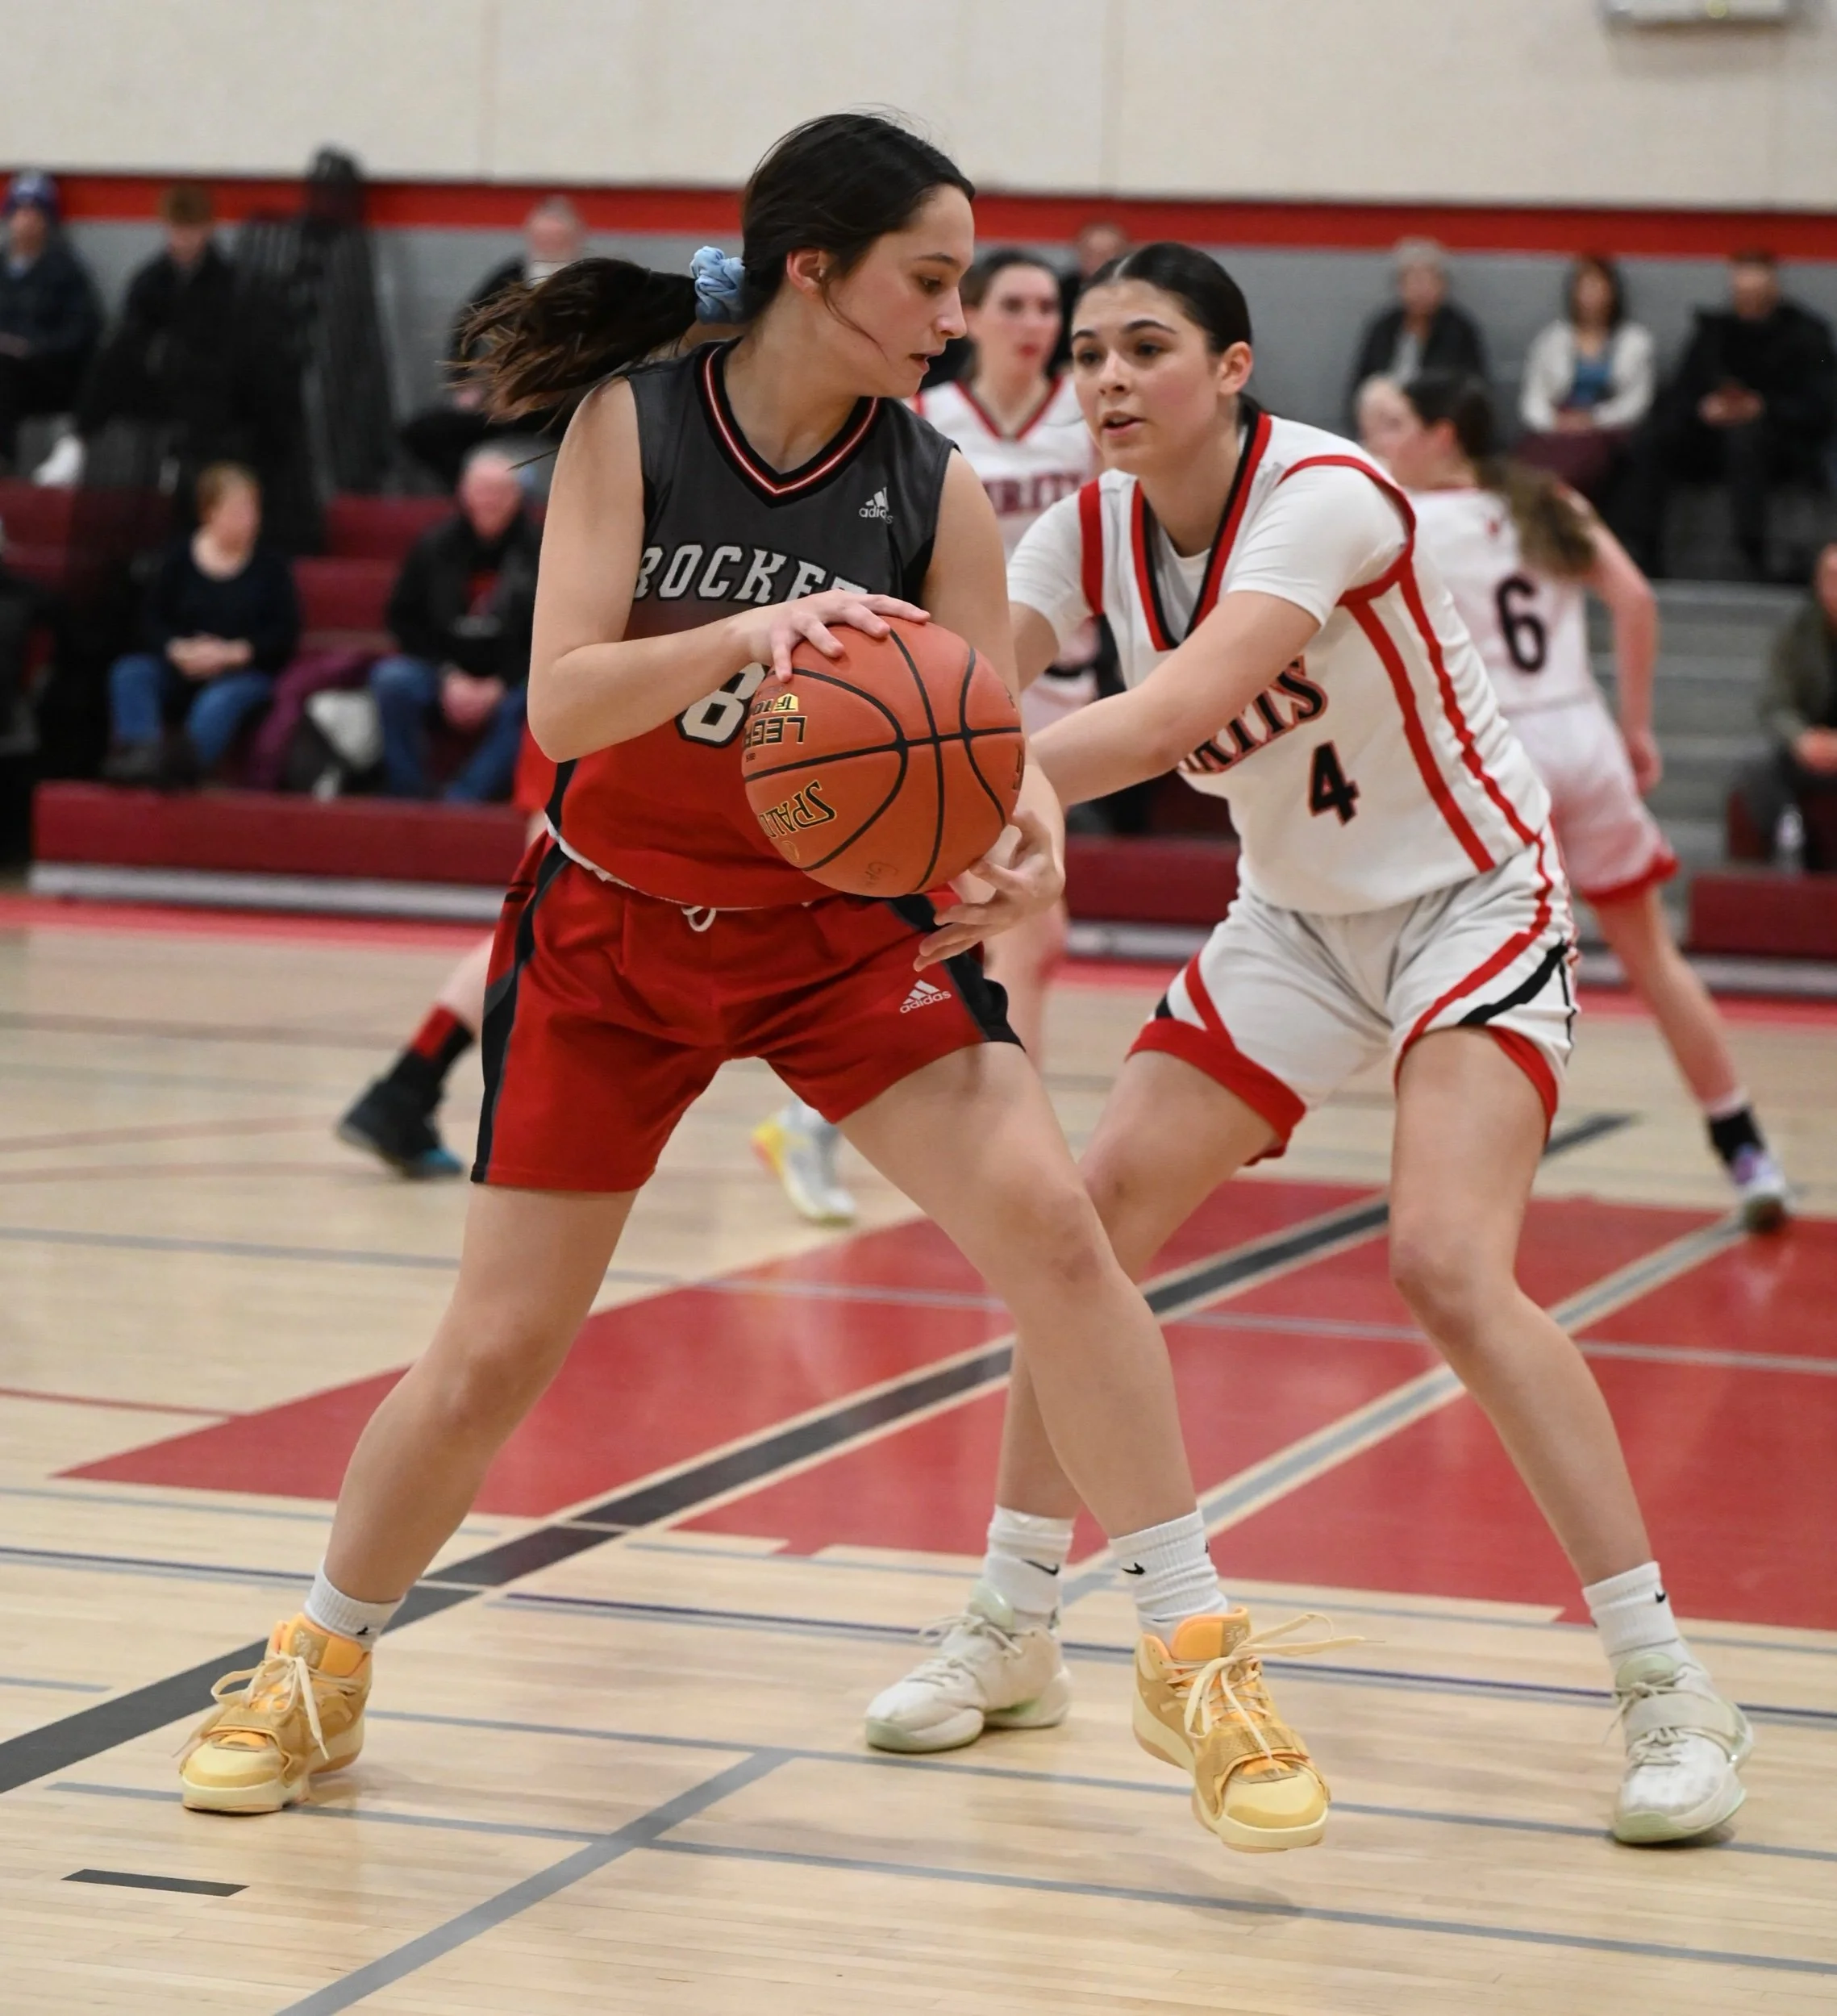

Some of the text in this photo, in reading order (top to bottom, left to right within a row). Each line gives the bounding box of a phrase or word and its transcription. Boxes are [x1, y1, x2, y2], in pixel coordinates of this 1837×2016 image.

[633, 542, 870, 605] ROCKE
[1496, 576, 1546, 674] 6
[674, 660, 769, 748] 8
[1308, 739, 1360, 827] 4
[899, 990, 952, 1014] adidas
